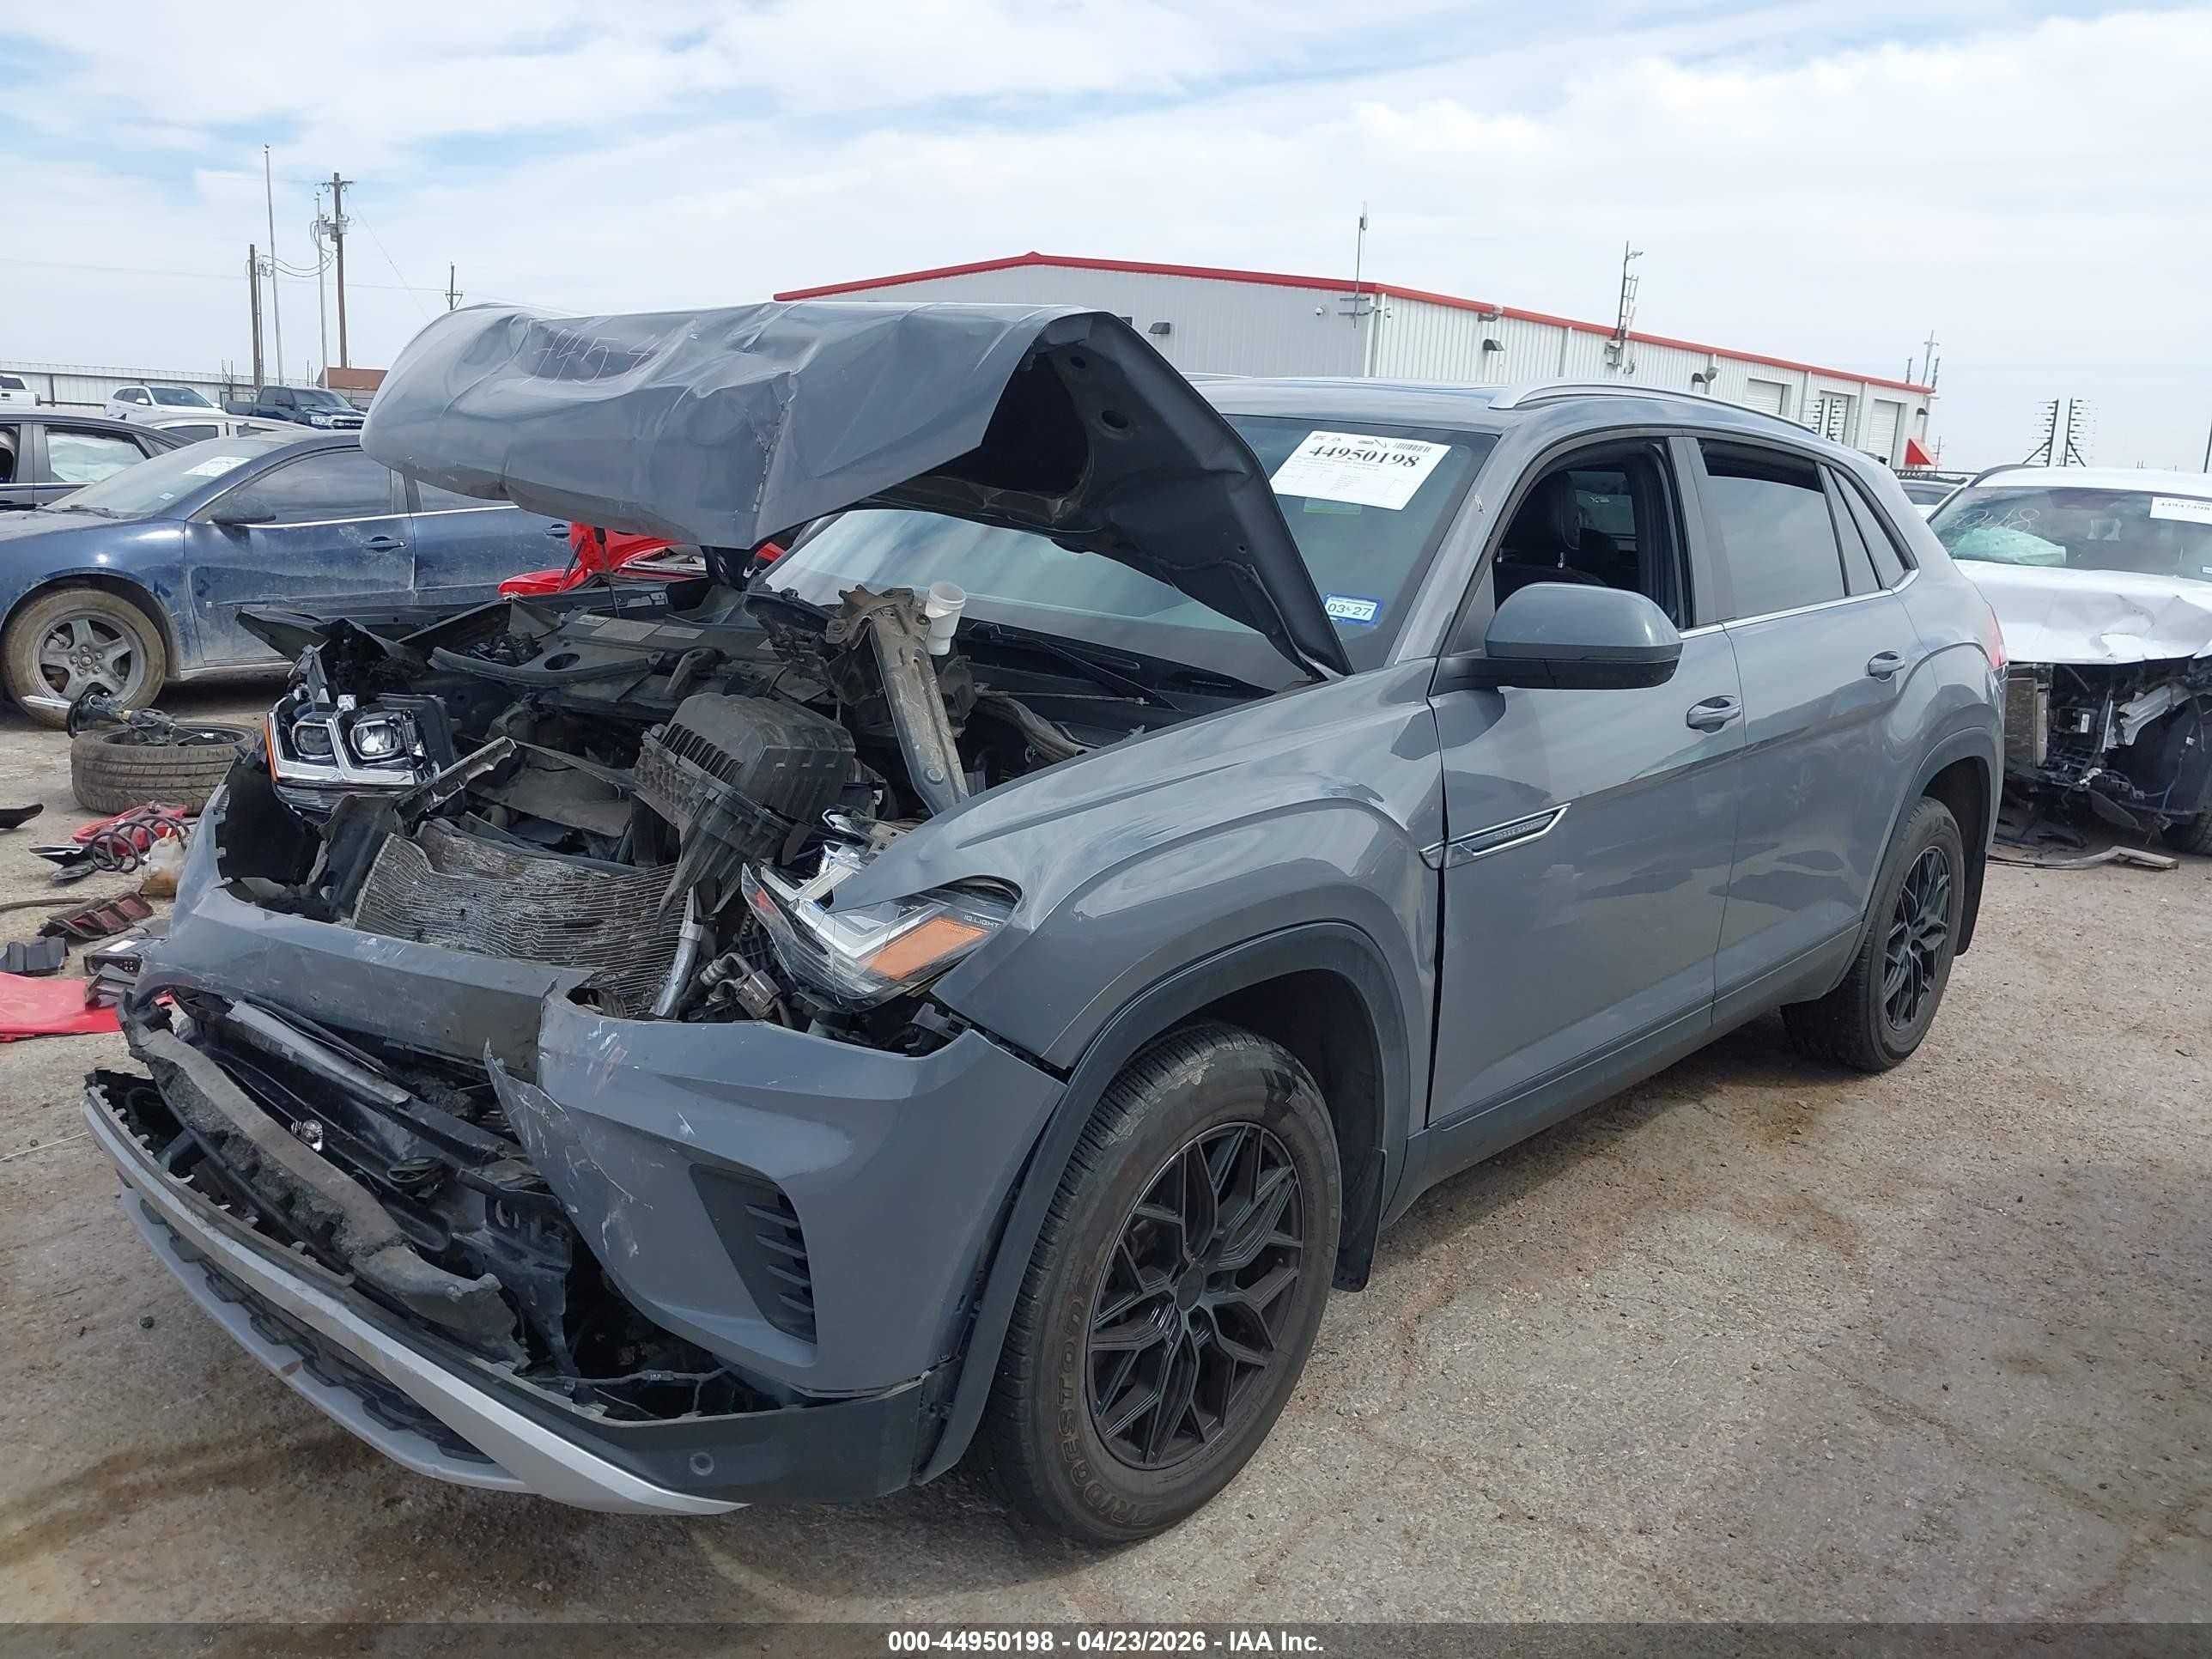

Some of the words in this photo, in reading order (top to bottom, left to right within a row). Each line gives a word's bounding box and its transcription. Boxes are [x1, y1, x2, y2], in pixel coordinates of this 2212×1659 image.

[1310, 445, 1420, 468] 44950198
[1328, 603, 1346, 613] 03
[1352, 606, 1371, 617] 27
[963, 915, 1000, 928] IQ.LIGHT
[1056, 1264, 1159, 1527] BRIDGESTONE
